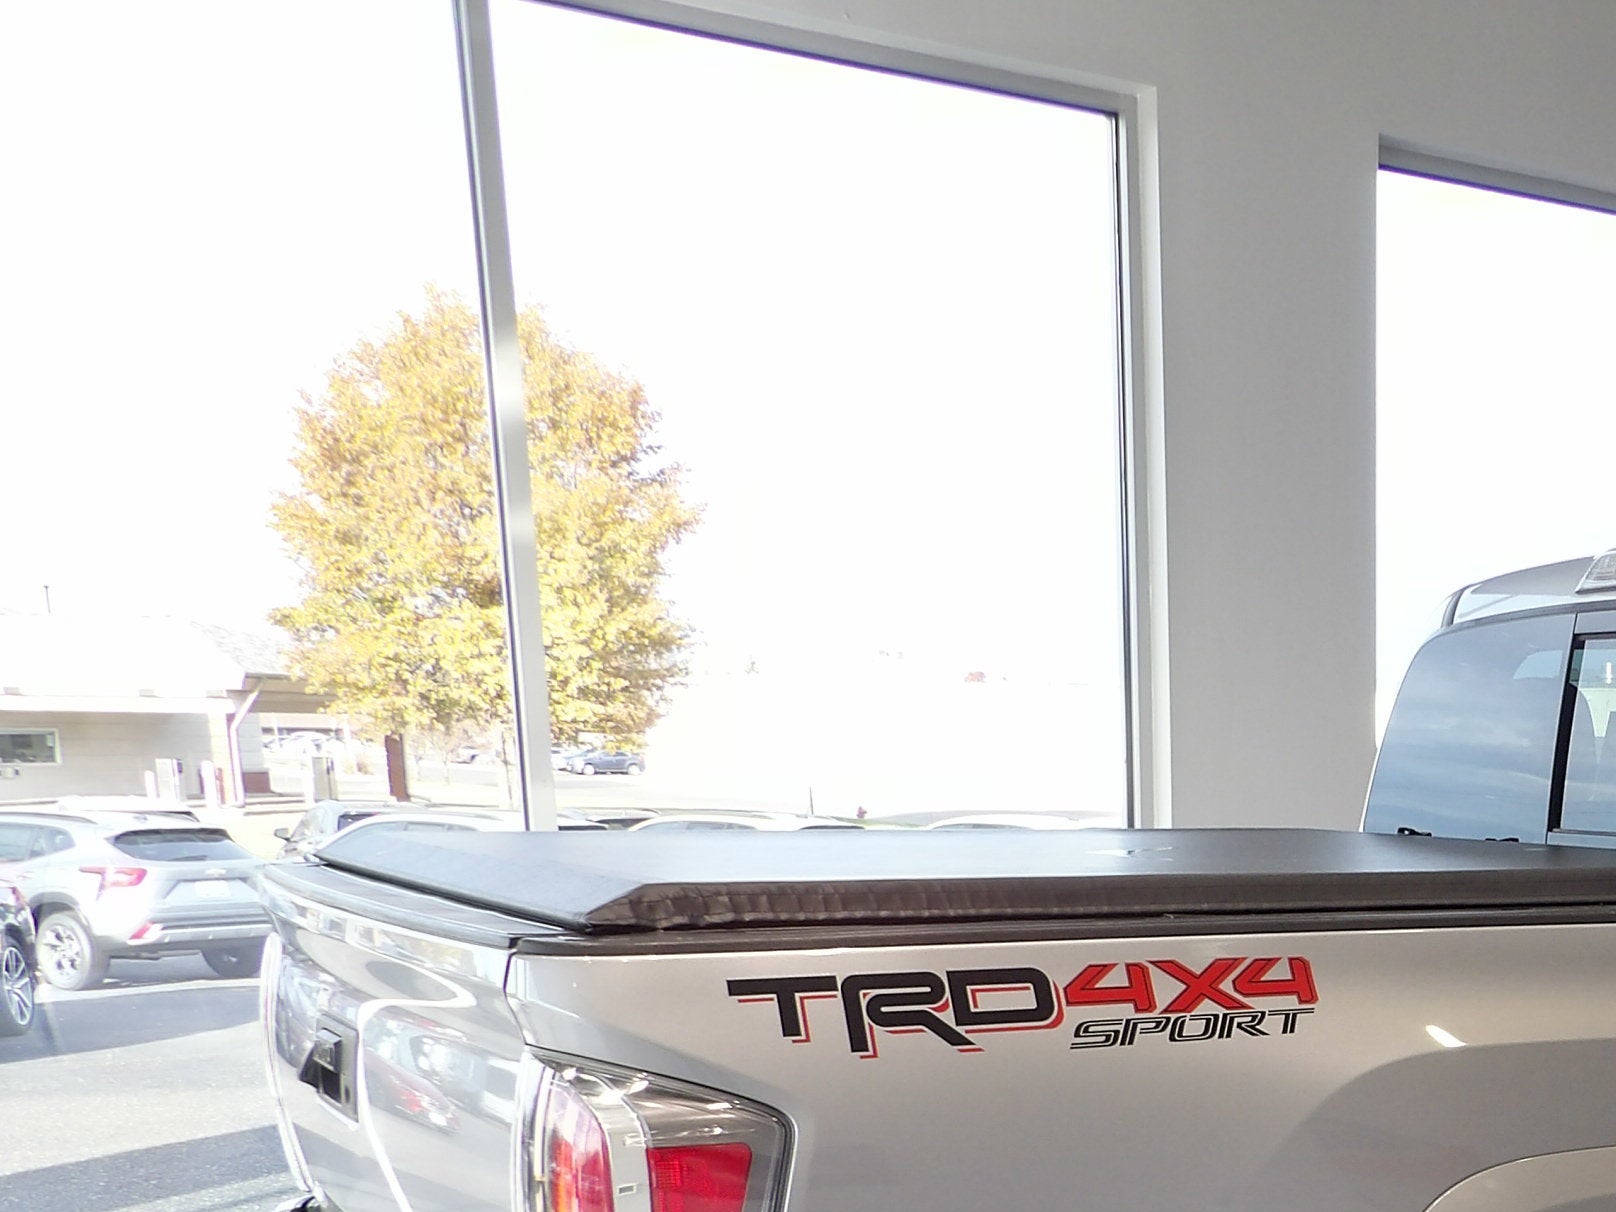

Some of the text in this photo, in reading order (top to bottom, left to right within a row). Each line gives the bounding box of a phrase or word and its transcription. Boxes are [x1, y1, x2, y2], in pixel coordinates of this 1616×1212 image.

[726, 956, 1320, 1059] TRD 4X4
[1069, 1007, 1316, 1050] SPORT
